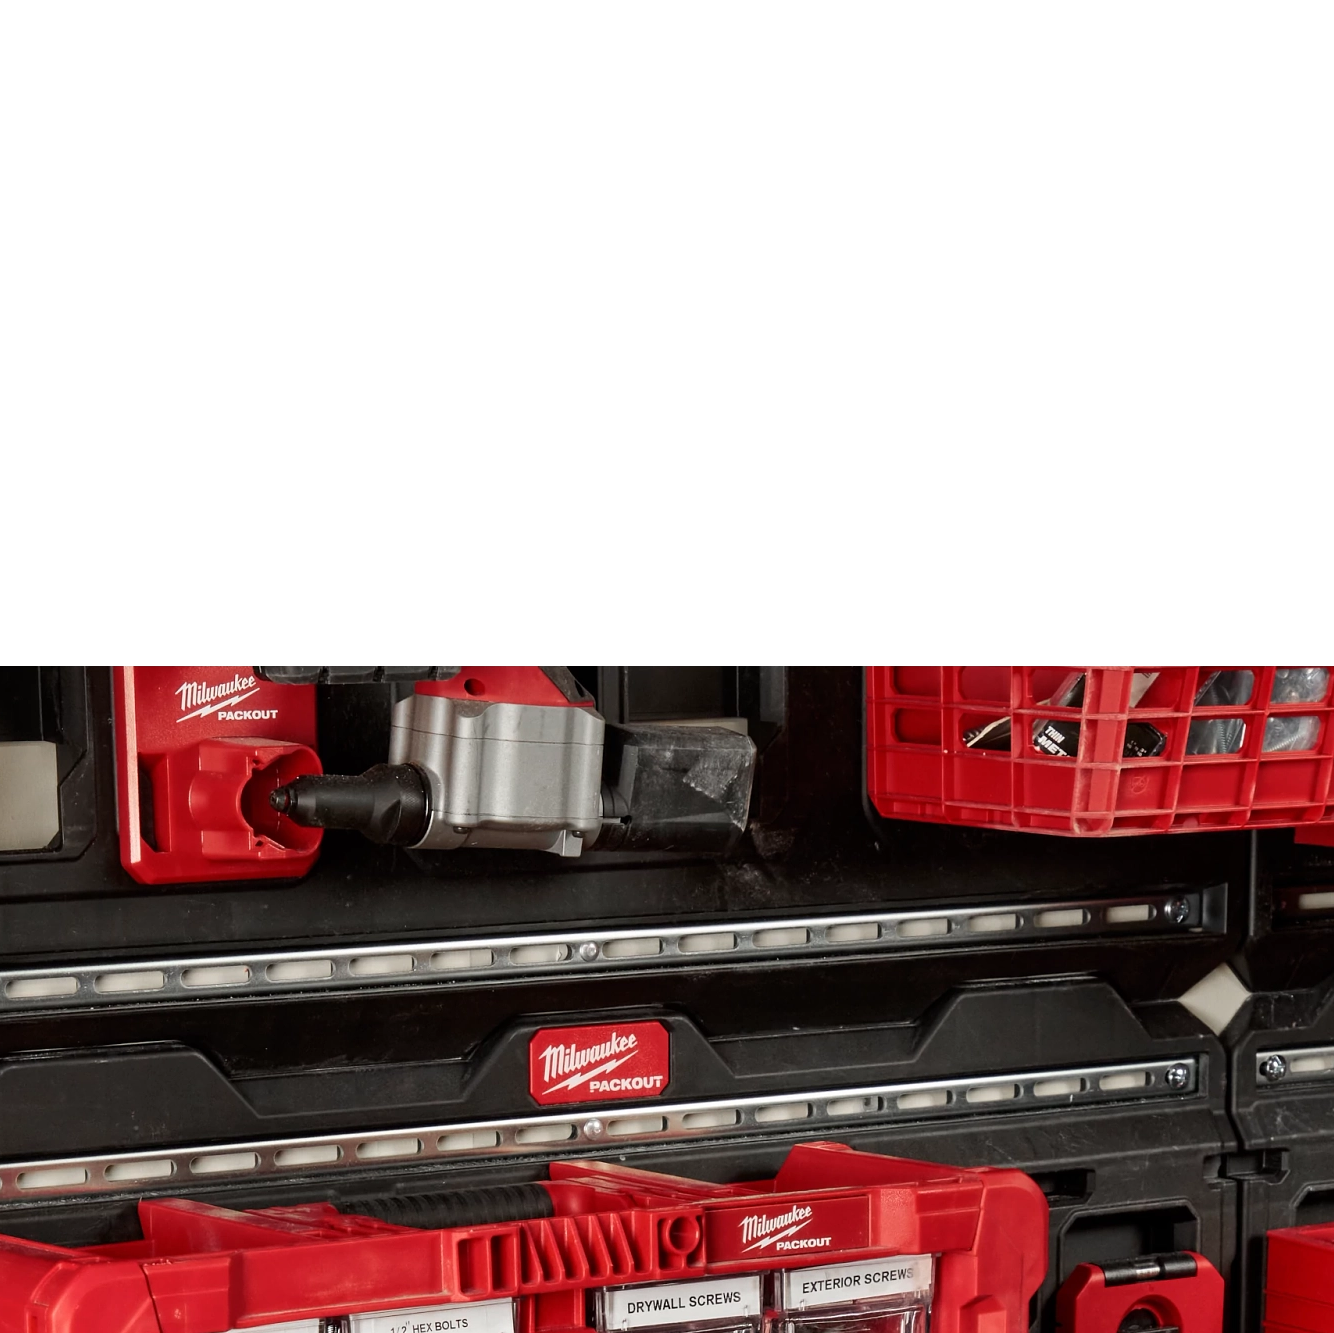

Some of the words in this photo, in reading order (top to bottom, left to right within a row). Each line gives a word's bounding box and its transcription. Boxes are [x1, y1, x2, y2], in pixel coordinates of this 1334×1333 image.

[176, 674, 257, 716] Milwaukee
[217, 708, 278, 721] PACKOUT
[1045, 725, 1065, 744] THIN
[540, 1032, 637, 1081] Milwaukee
[589, 1075, 663, 1093] PACKOUT
[738, 1205, 813, 1243] Milwaukee
[776, 1237, 831, 1251] PACKOUT
[802, 1275, 861, 1294] EXTERIOR
[864, 1268, 914, 1286] SCREWS
[627, 1296, 686, 1314] DRYWALL
[688, 1291, 742, 1308] SCREWS
[435, 1318, 469, 1333] BOLTS
